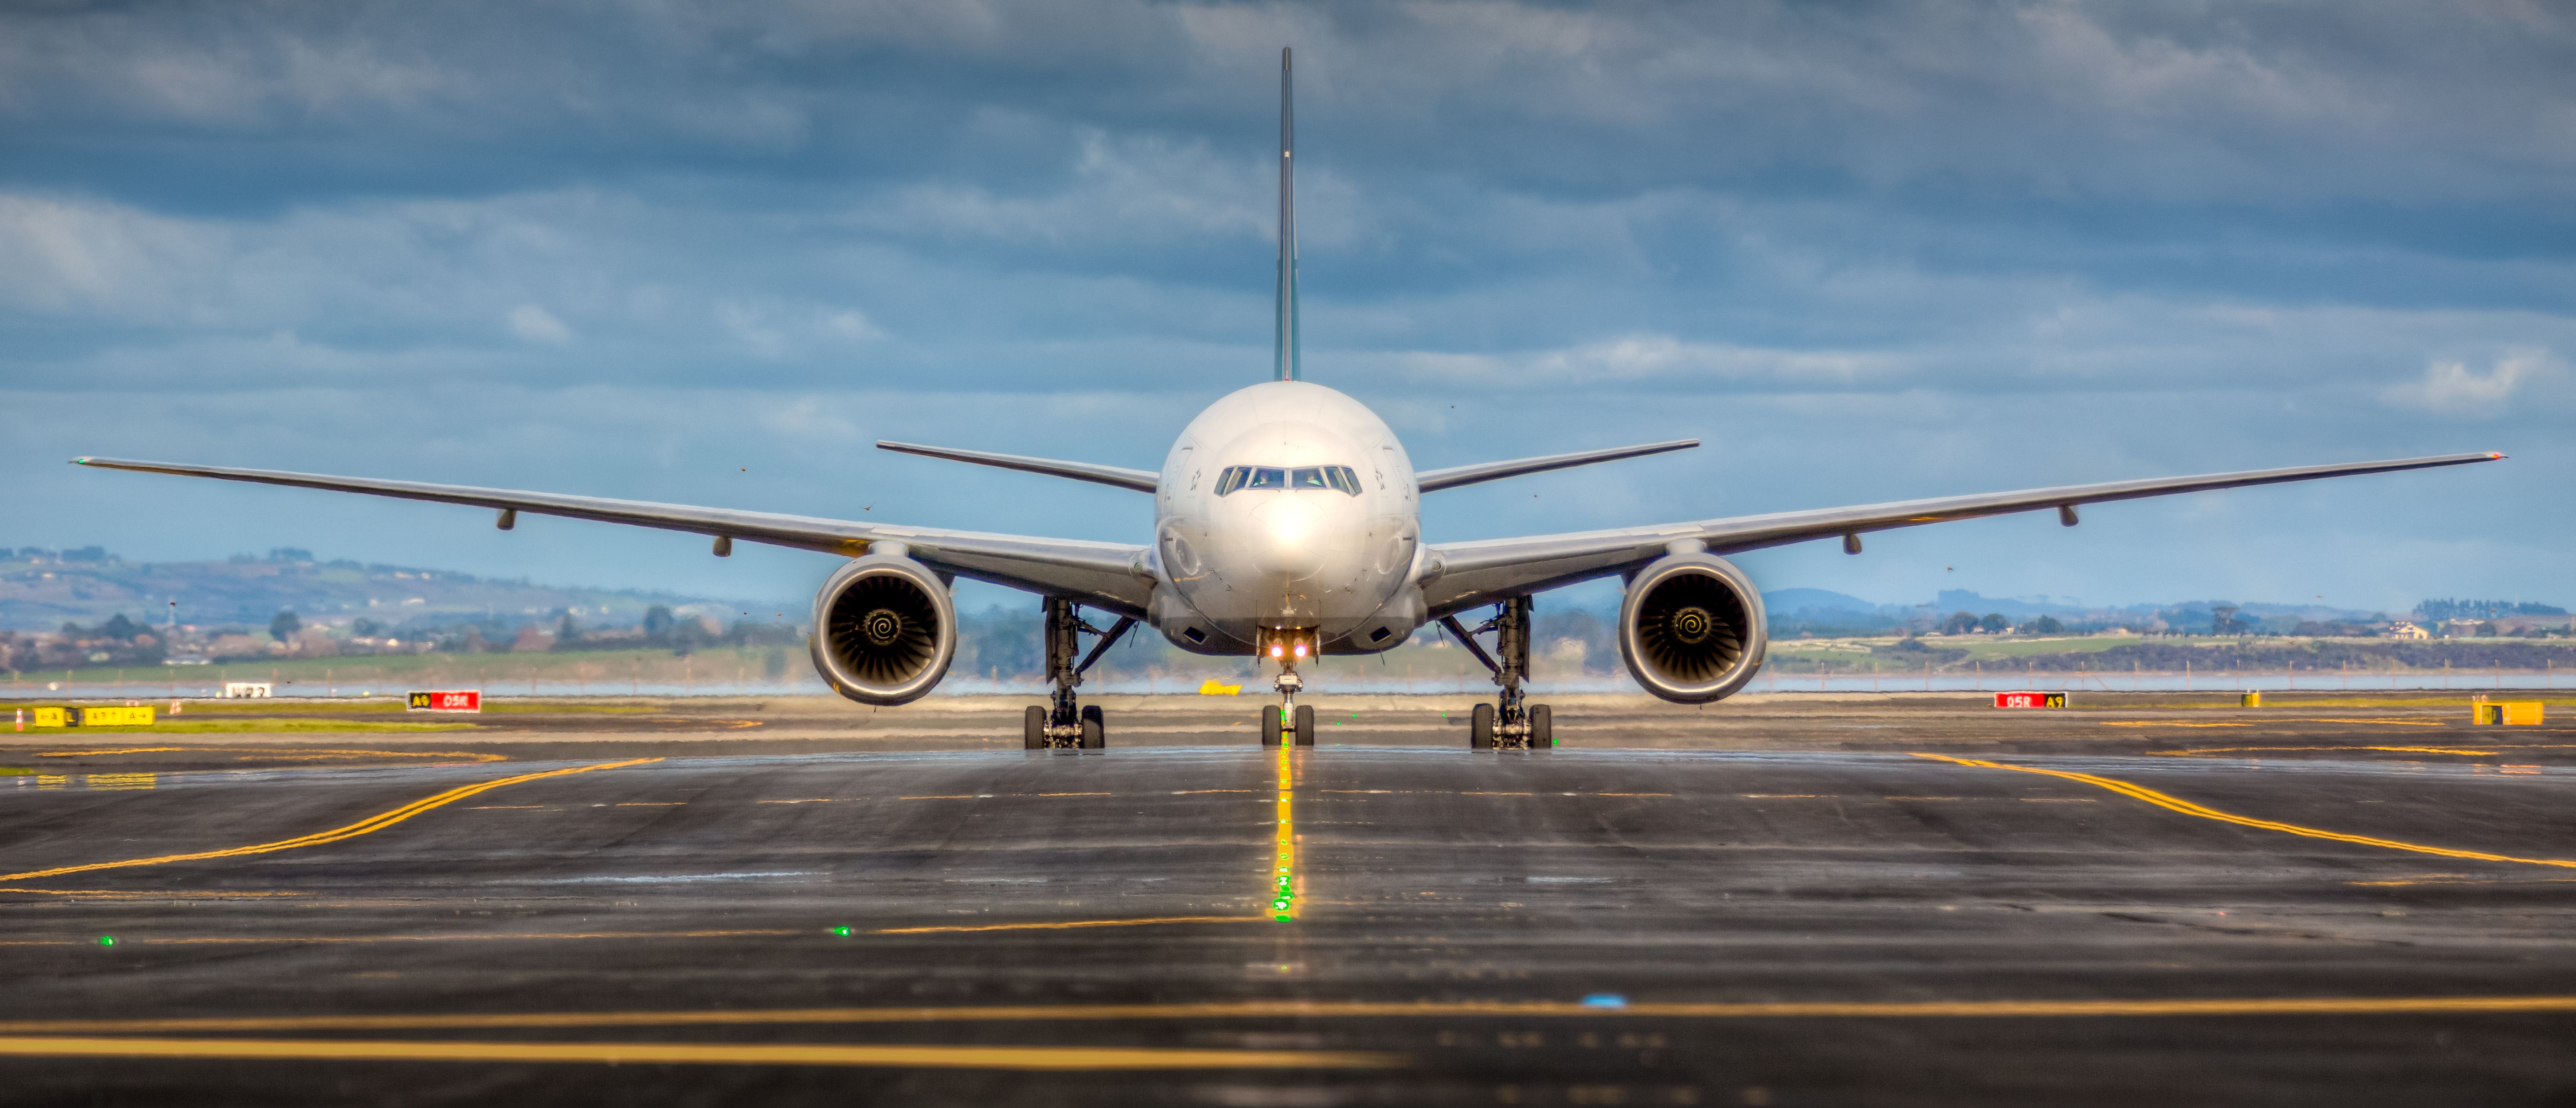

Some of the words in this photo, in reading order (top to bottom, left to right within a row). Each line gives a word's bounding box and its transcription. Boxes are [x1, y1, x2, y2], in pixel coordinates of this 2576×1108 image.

[412, 695, 430, 707] A9
[443, 694, 469, 708] 05R
[2007, 696, 2031, 708] 05R
[2046, 696, 2064, 709] A9
